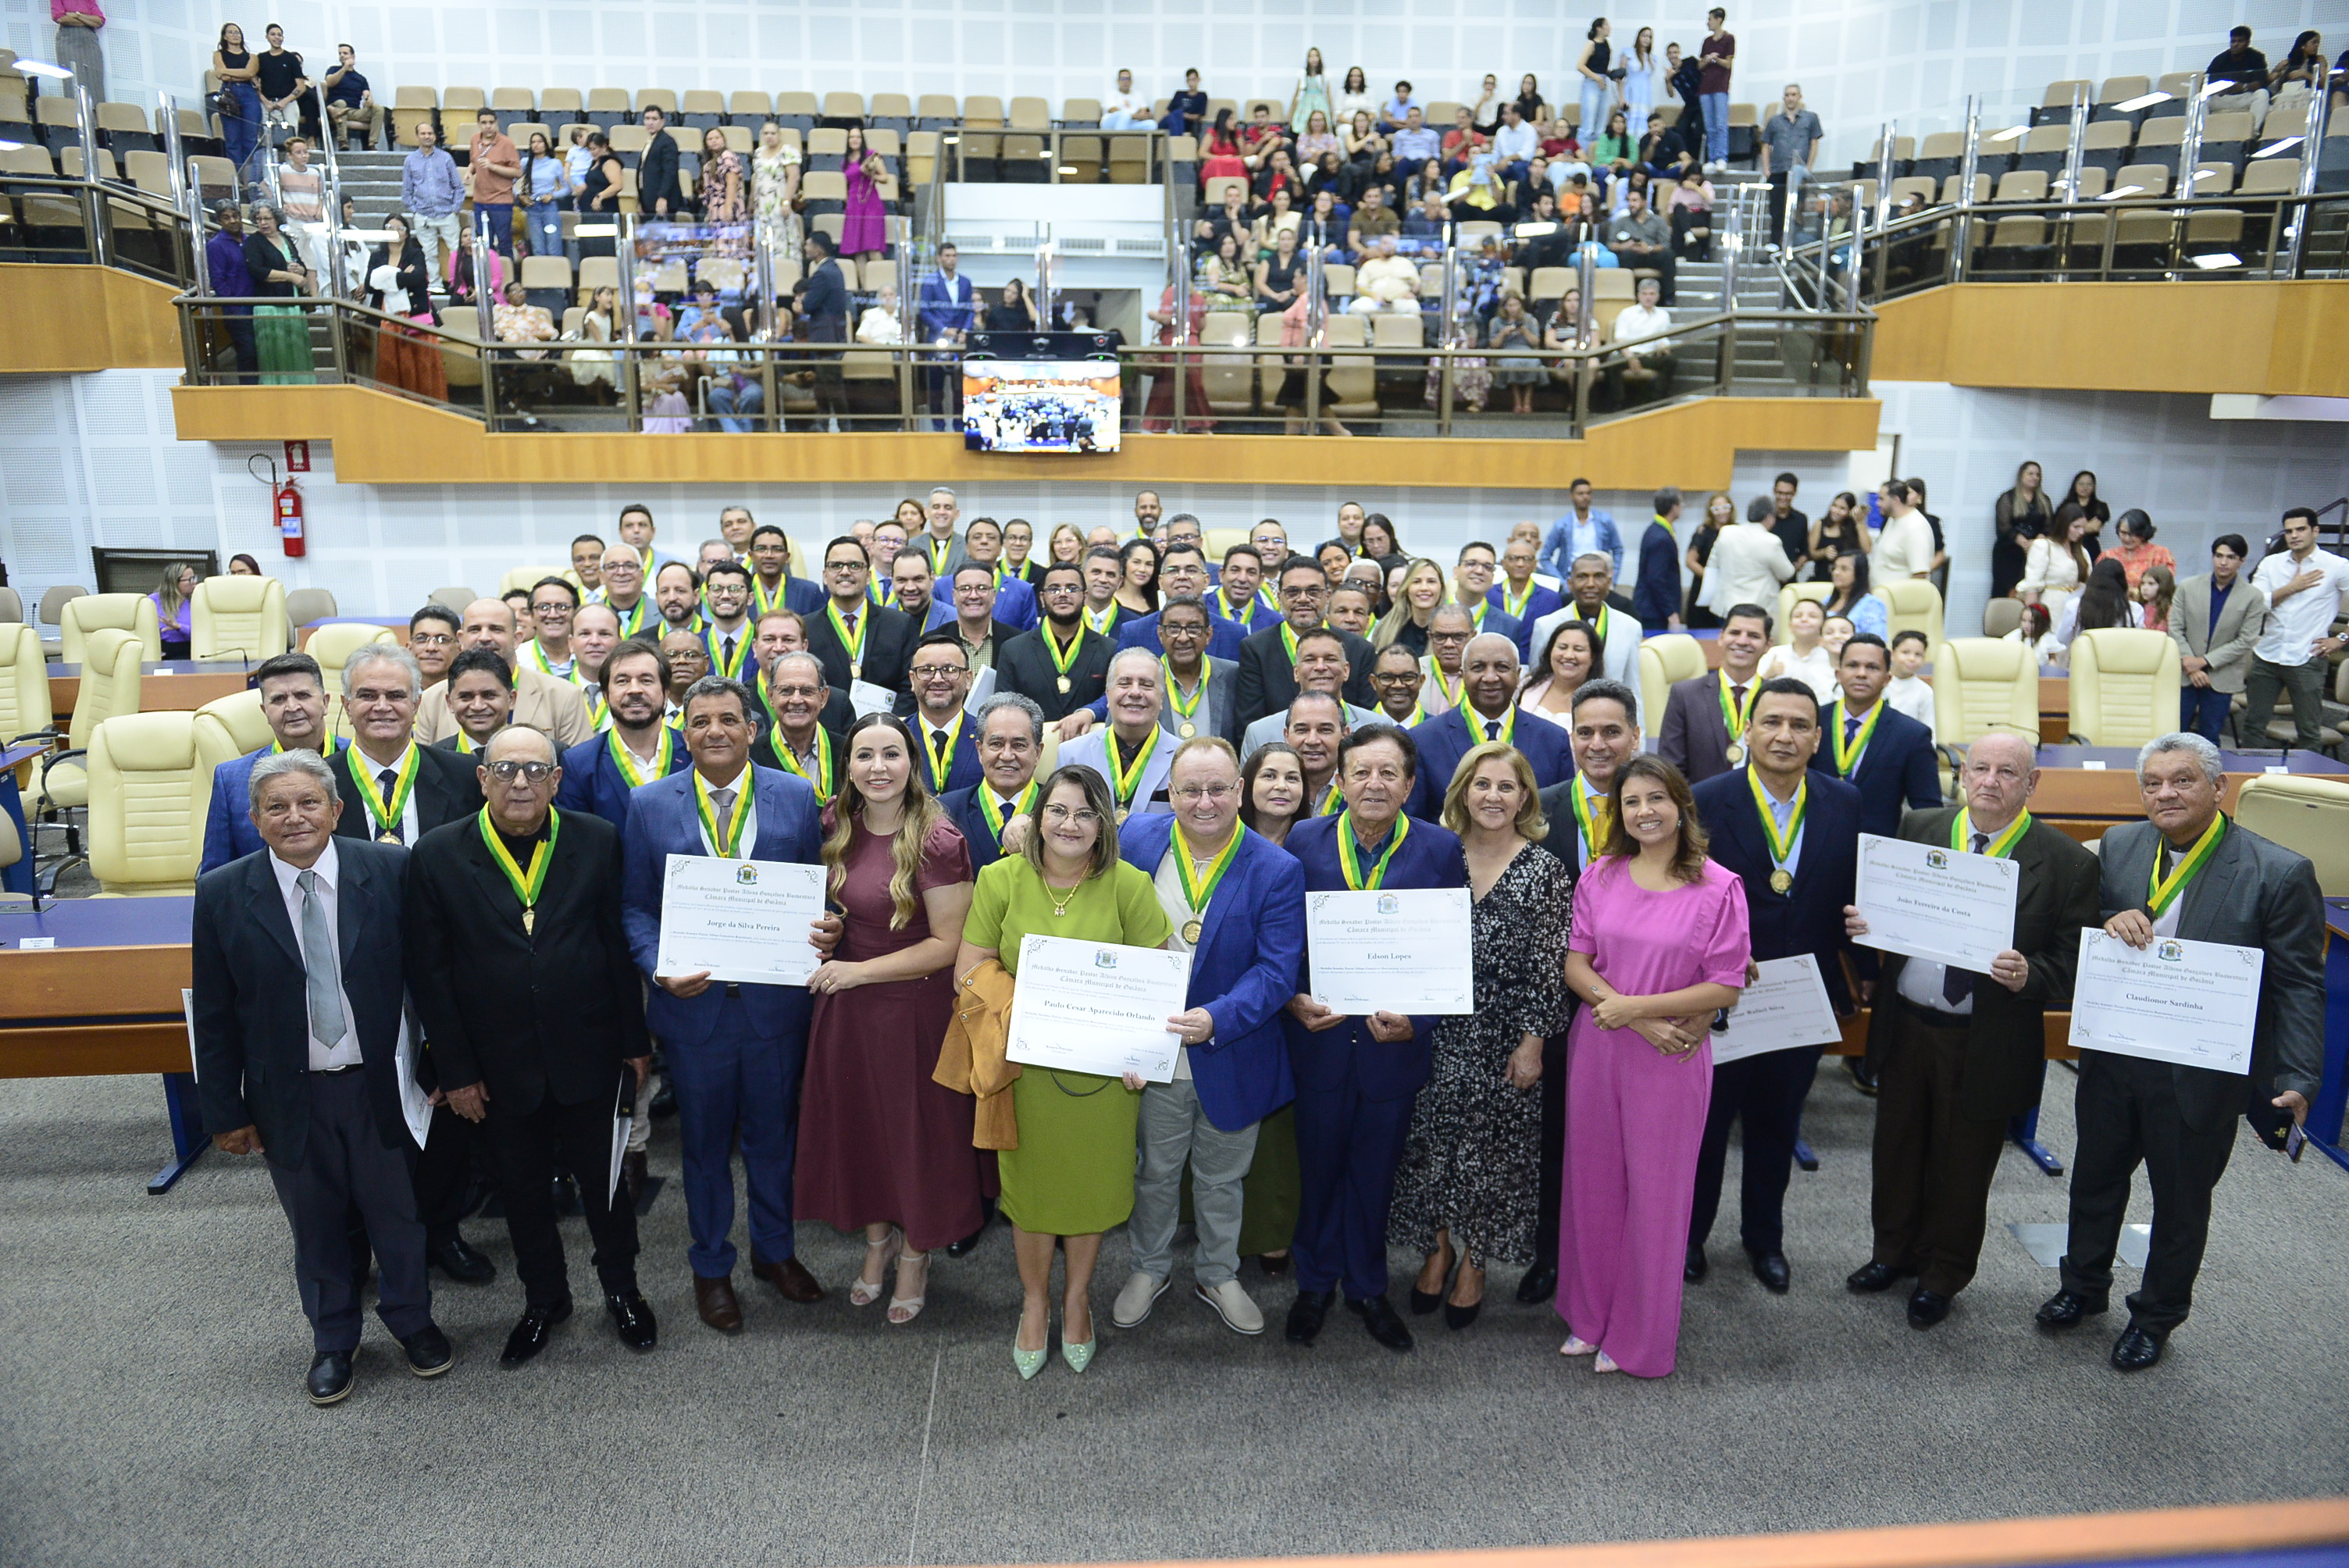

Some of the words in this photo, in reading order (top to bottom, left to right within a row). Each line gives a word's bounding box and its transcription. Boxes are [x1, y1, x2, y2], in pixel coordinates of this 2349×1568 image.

[1915, 900, 1940, 911] Ferreira
[1952, 908, 1971, 917] Costa
[2126, 993, 2167, 1005] Claudionor
[2169, 1000, 2203, 1010] Sardinha
[1044, 1000, 1064, 1009] Paulo
[1067, 1003, 1086, 1012] Cesar
[1088, 1006, 1124, 1017] Aparecido
[1127, 1011, 1155, 1021] Orlando
